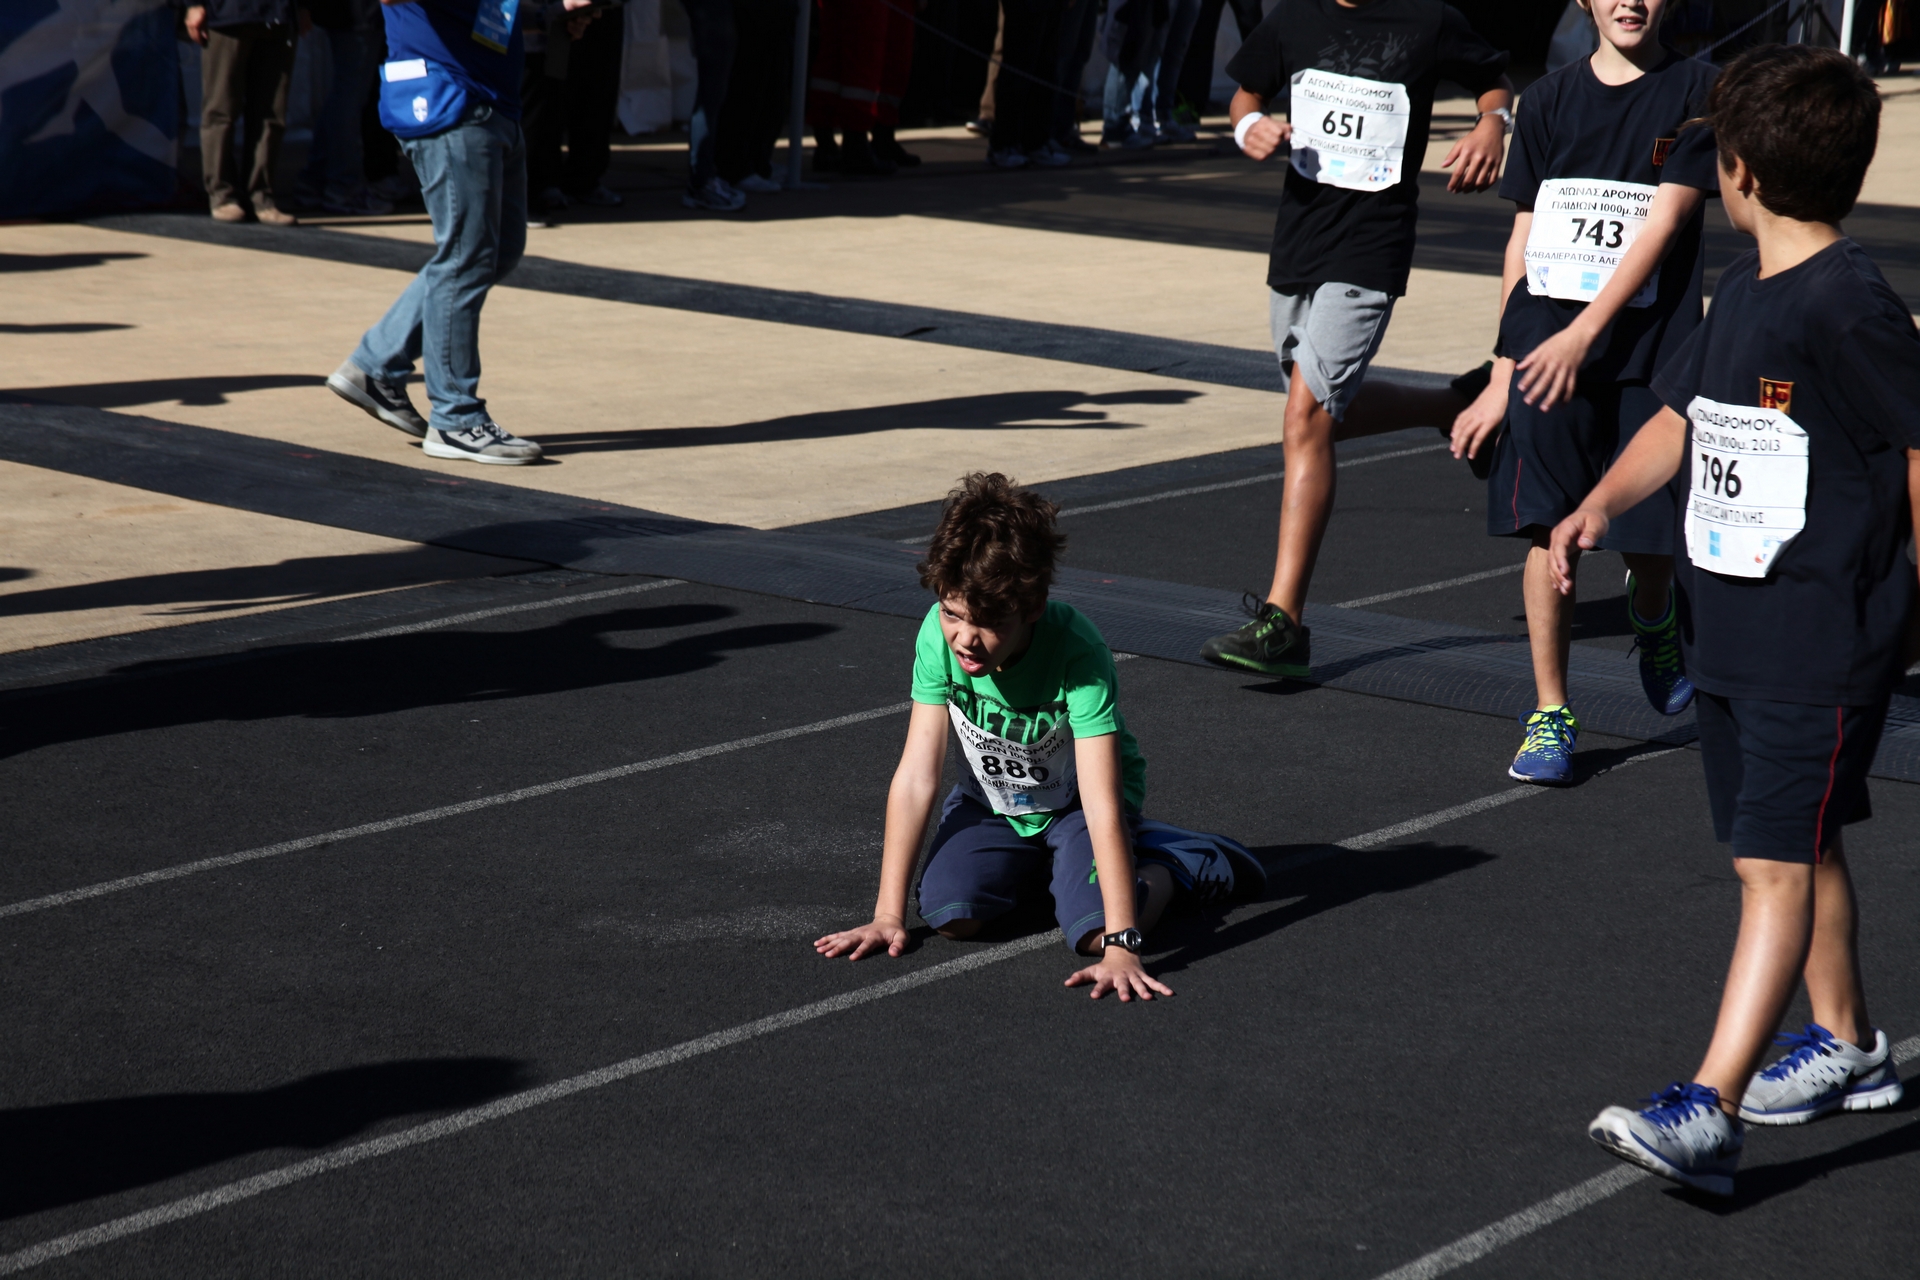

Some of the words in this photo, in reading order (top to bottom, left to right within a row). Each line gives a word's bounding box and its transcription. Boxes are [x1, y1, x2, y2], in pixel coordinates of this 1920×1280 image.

[1304, 89, 1343, 105] ΠΑΙΔΙΩΝ
[1375, 103, 1394, 112] 2013
[1308, 77, 1346, 93] ΑΓΩΝΑΣ
[1348, 84, 1393, 99] ΔΡΟΜΟΥ
[1322, 110, 1364, 140] 651
[1558, 187, 1600, 197] ΑΓΩΝΑΣ
[1551, 200, 1597, 211] ΠΑΙΔΙΩΝ
[1634, 206, 1649, 217] 201
[1571, 218, 1624, 248] 743
[1525, 250, 1596, 263] ΚΑΒΑΛΙΕΡΑΤΟΣ
[1752, 439, 1780, 451] 2013
[1701, 453, 1742, 499] 796
[959, 728, 1007, 755] ΠΑΙΔΙΩΝ
[1045, 739, 1065, 758] 2013
[961, 721, 1006, 747] ΑΓΩΝΑΣ
[1007, 732, 1057, 755] ΔΡΟΜΟΥ
[981, 755, 1049, 782] 880
